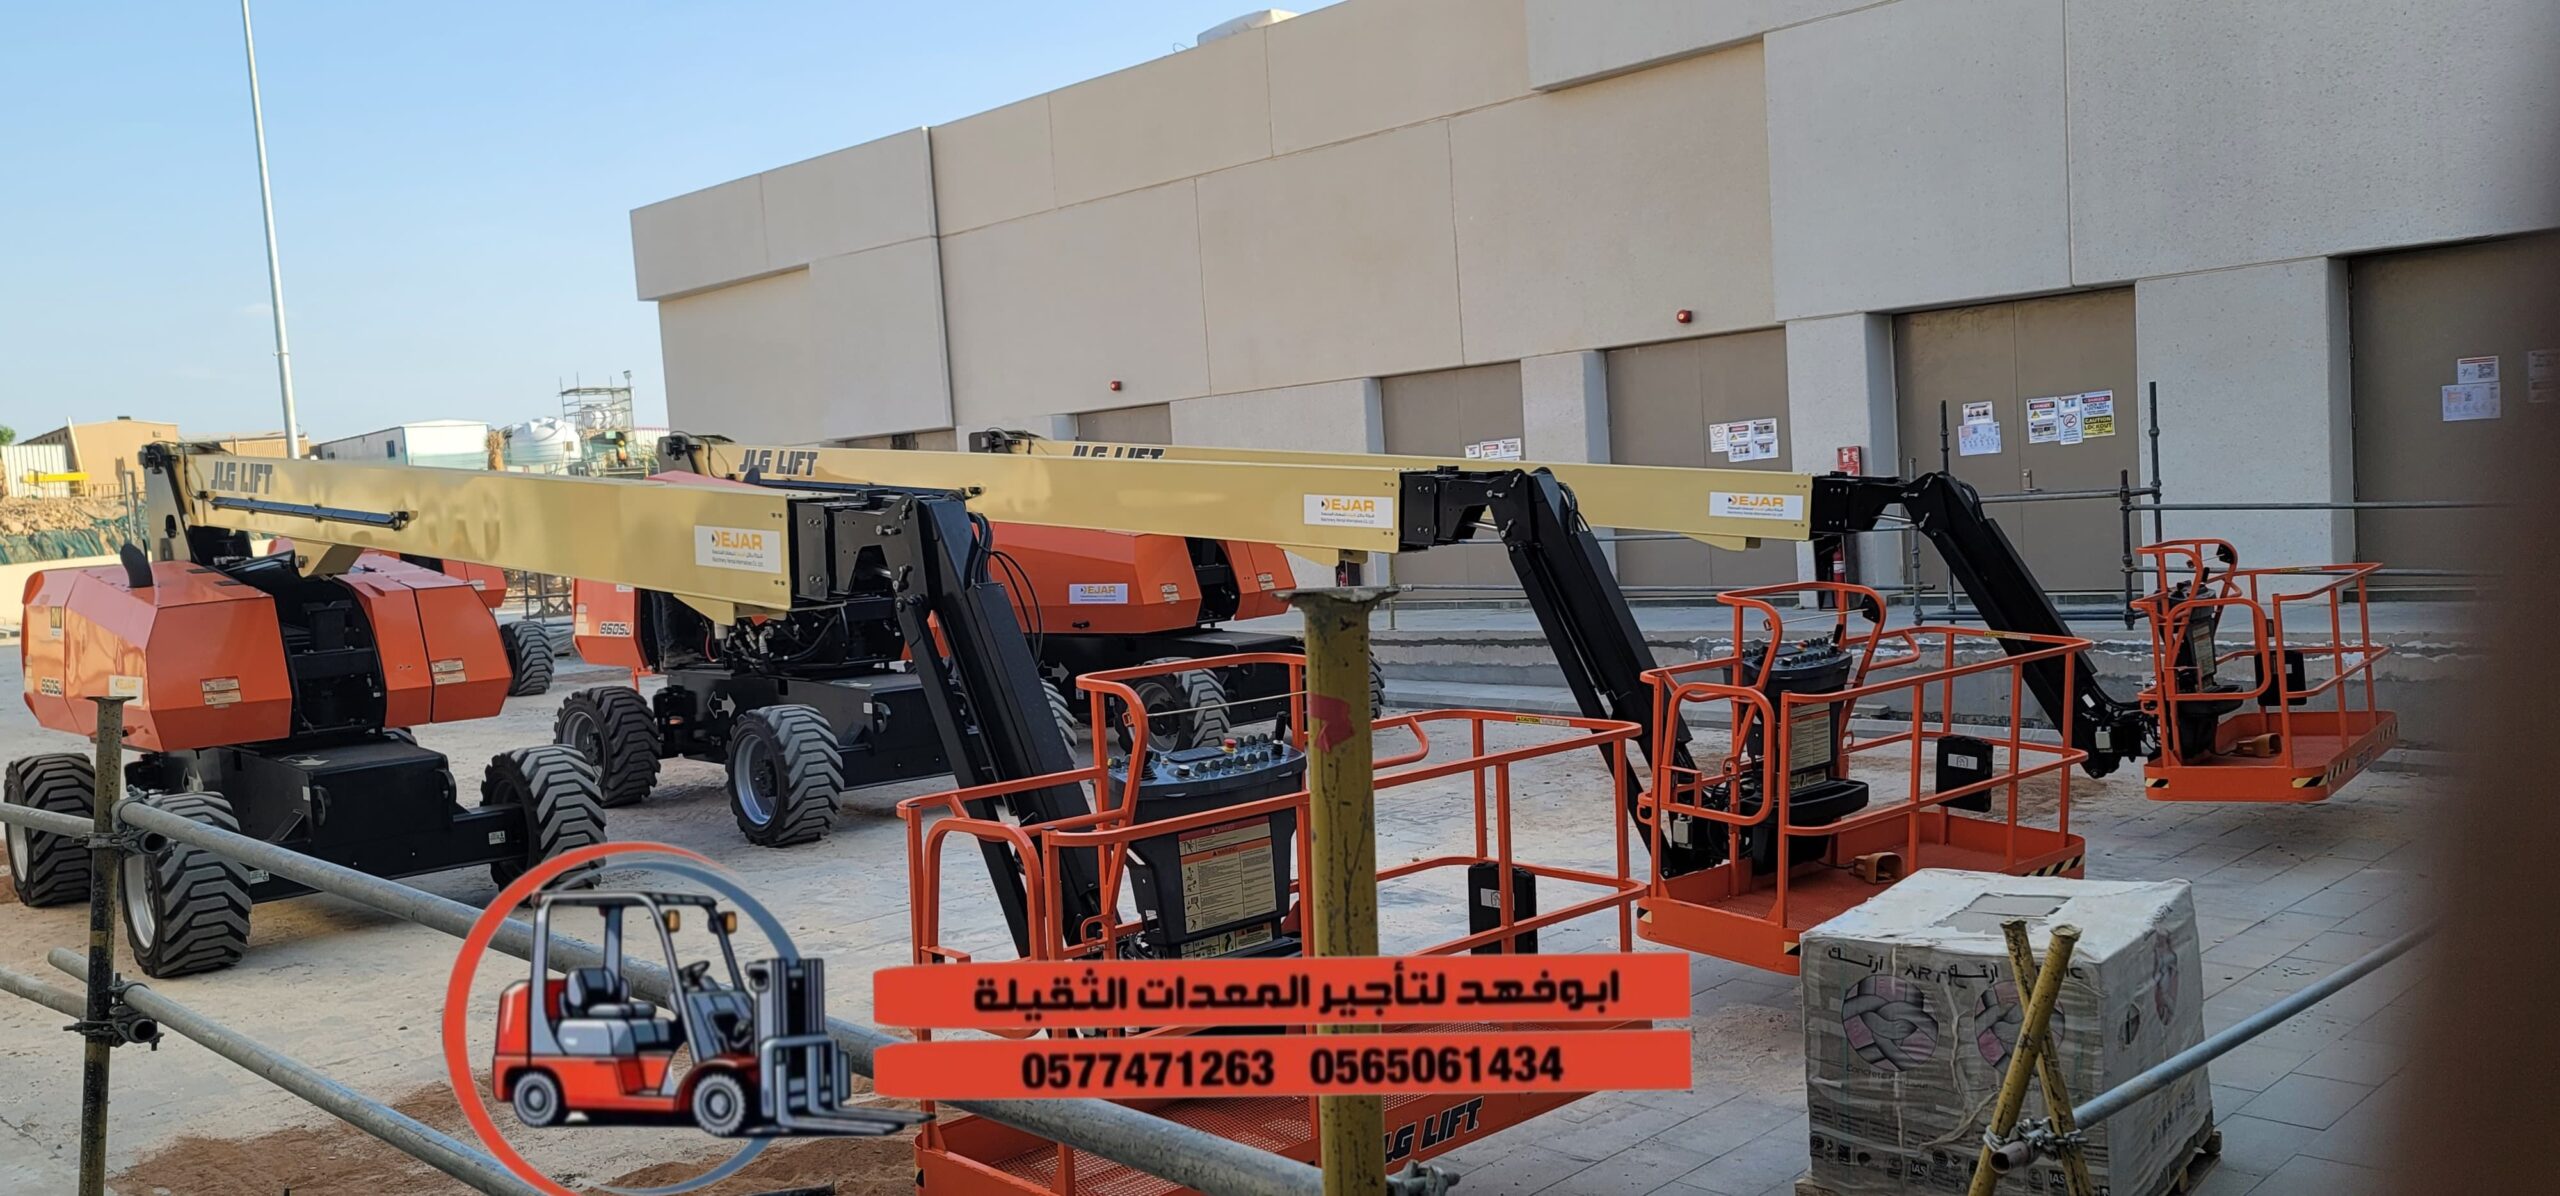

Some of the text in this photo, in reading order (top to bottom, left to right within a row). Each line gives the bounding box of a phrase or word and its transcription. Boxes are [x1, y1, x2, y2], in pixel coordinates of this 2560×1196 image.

[210, 461, 273, 495] JLG LIFT
[738, 449, 819, 476] JLG LIFT
[1383, 1095, 1484, 1166] LG LIFT
